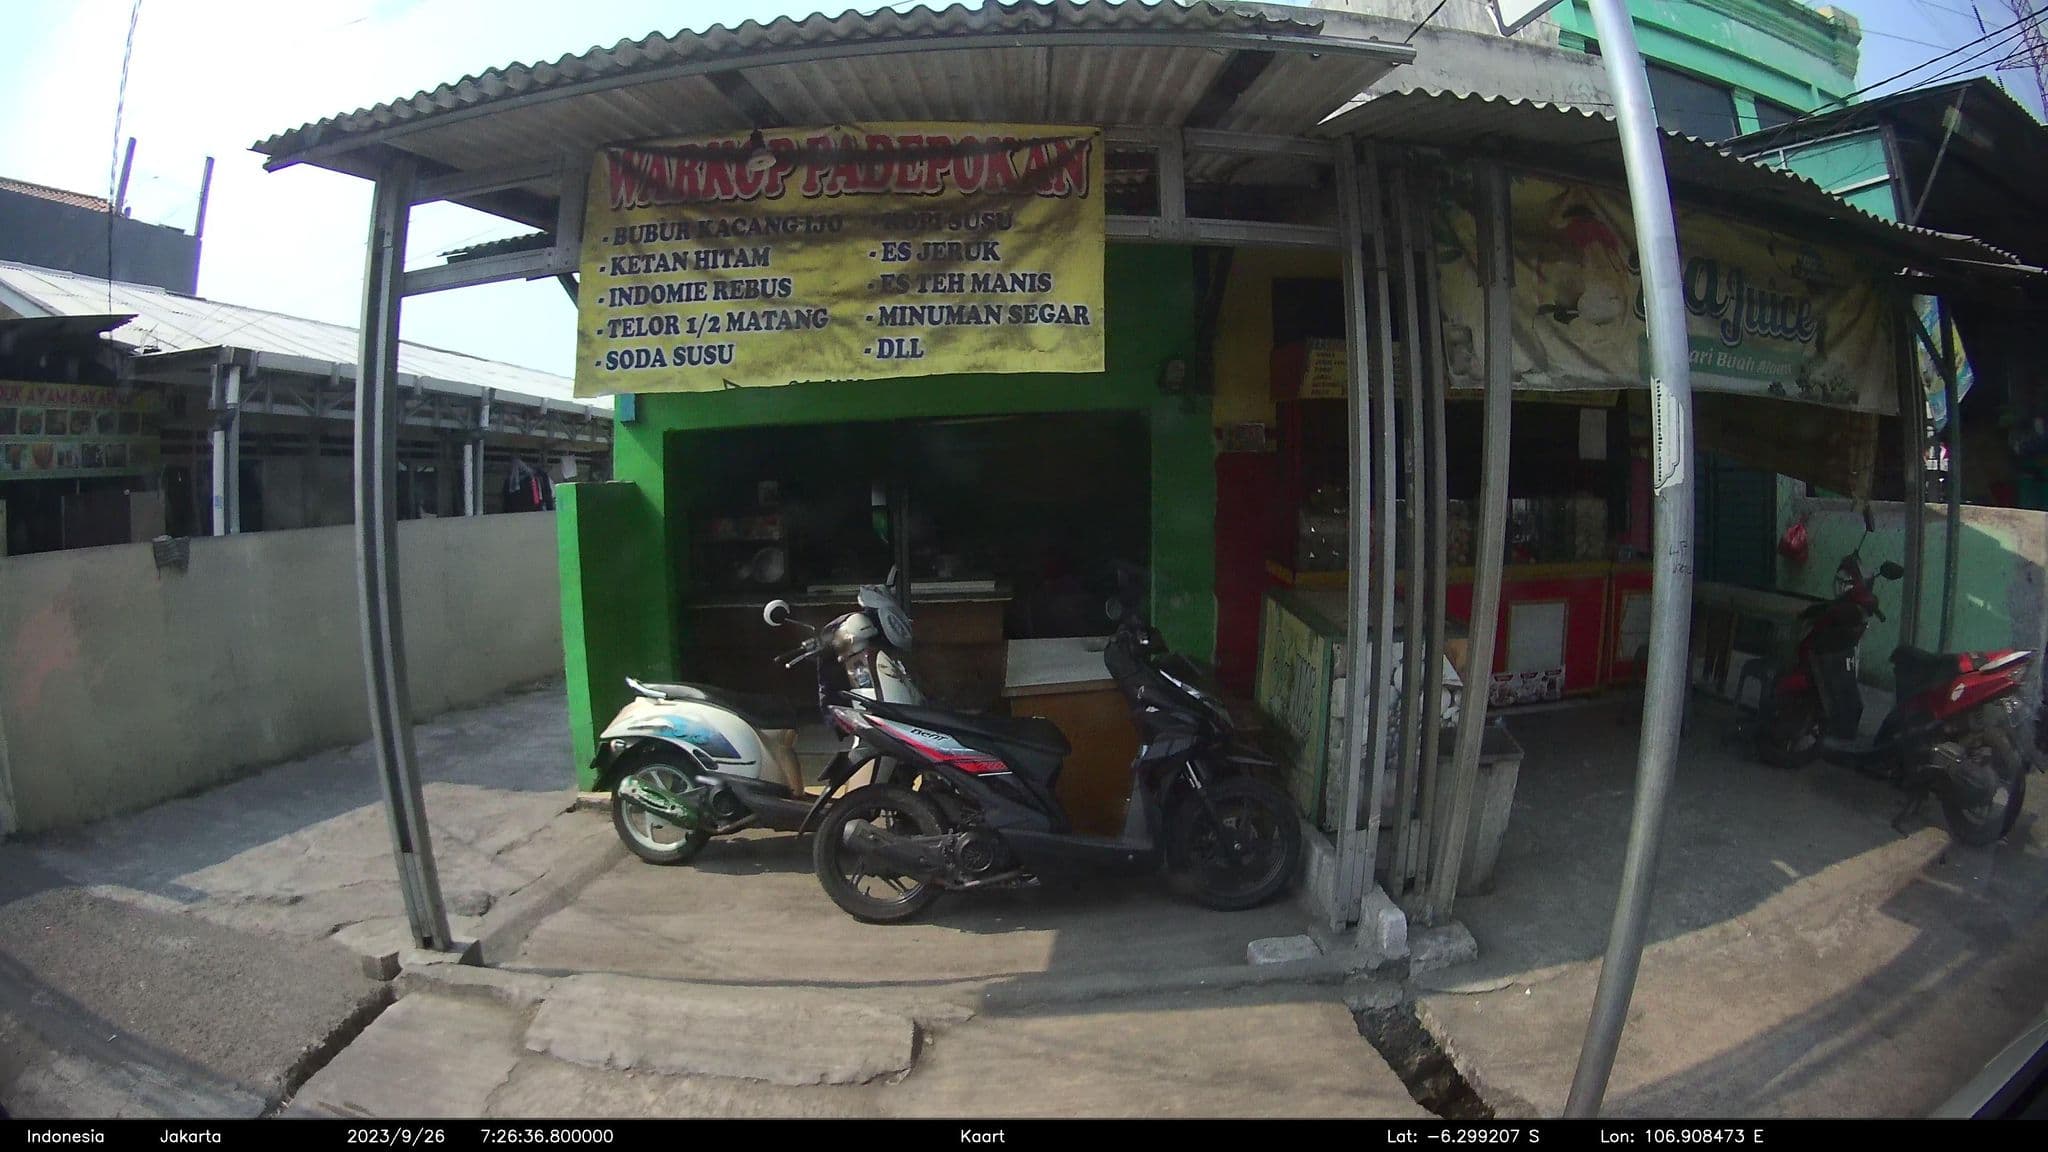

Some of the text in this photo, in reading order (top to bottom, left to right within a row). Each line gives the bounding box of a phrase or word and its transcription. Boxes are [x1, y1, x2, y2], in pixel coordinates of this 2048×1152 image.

[607, 134, 1092, 210] WARKOP PADEPOKAN
[613, 221, 691, 246] BUBUR
[698, 216, 799, 239] KACANG
[610, 247, 771, 275] KETAN HITAM
[881, 241, 1001, 262] ES JERUK
[608, 278, 792, 307] INDOMIE REBUS
[880, 272, 1052, 294] ES TEH MANIS
[607, 308, 829, 338] TELOR 1/2 MATANG
[878, 303, 1091, 326] MINUMAN SEGAR
[605, 344, 735, 371] SODA SUSU
[876, 338, 924, 359] DLL
